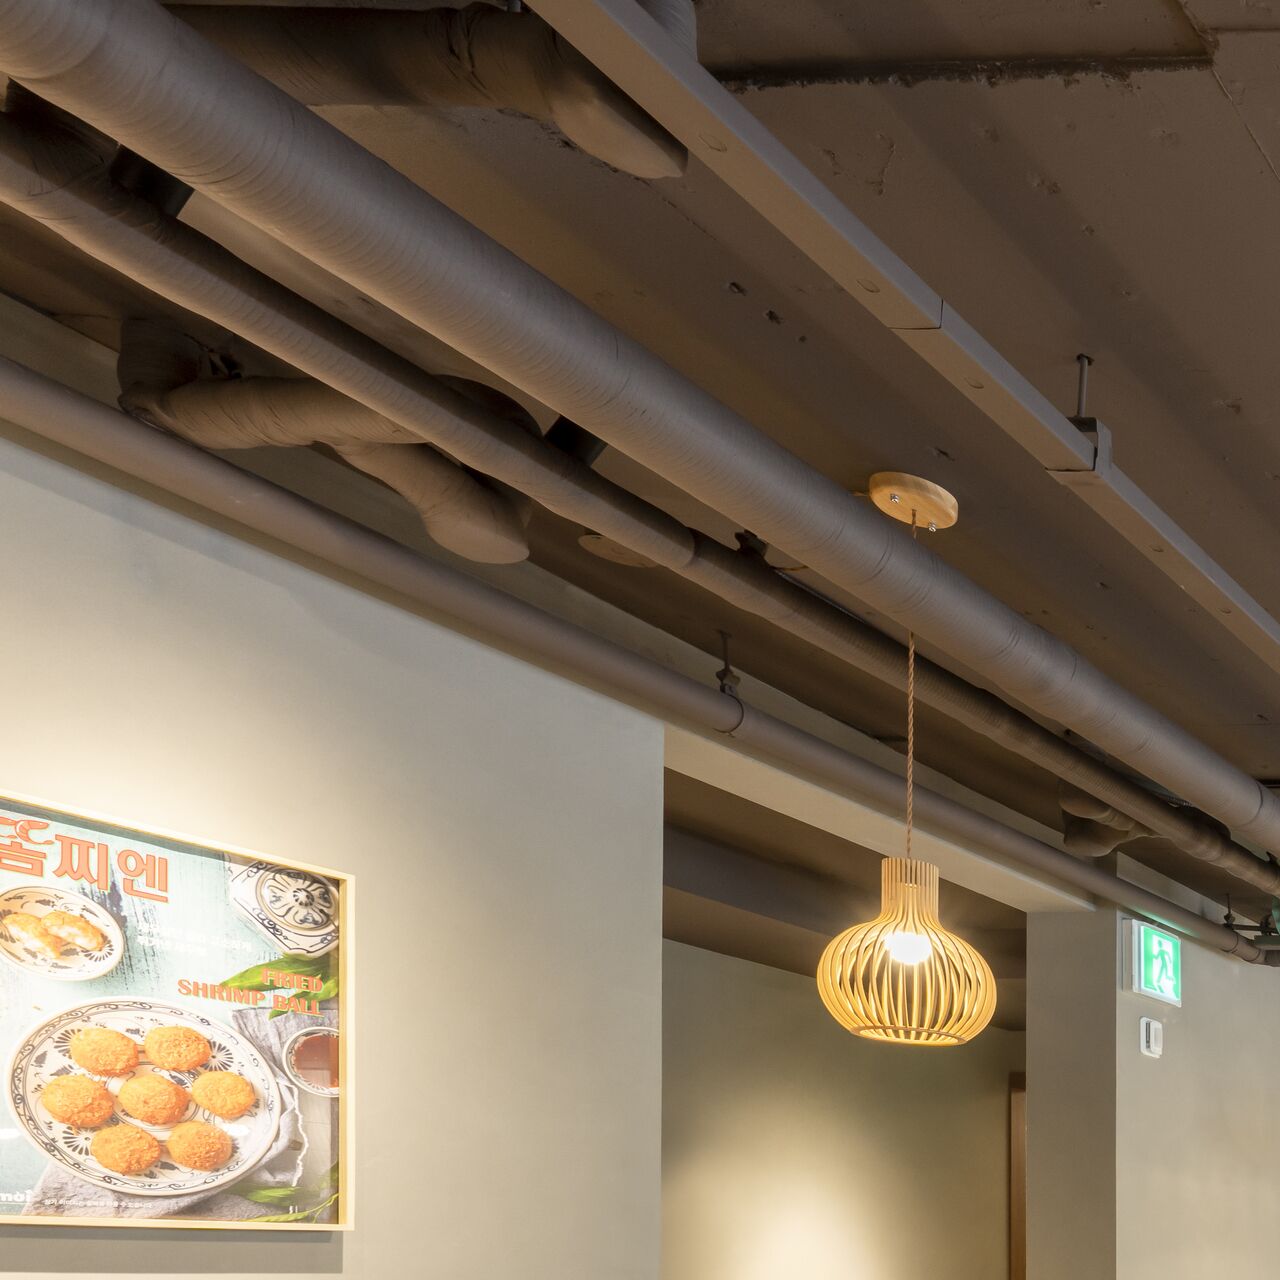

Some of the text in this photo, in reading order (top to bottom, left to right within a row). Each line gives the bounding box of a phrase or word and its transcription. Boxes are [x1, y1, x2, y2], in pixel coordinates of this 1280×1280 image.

[262, 968, 324, 993] FRIED
[177, 978, 323, 1017] SHRIMP BALL
